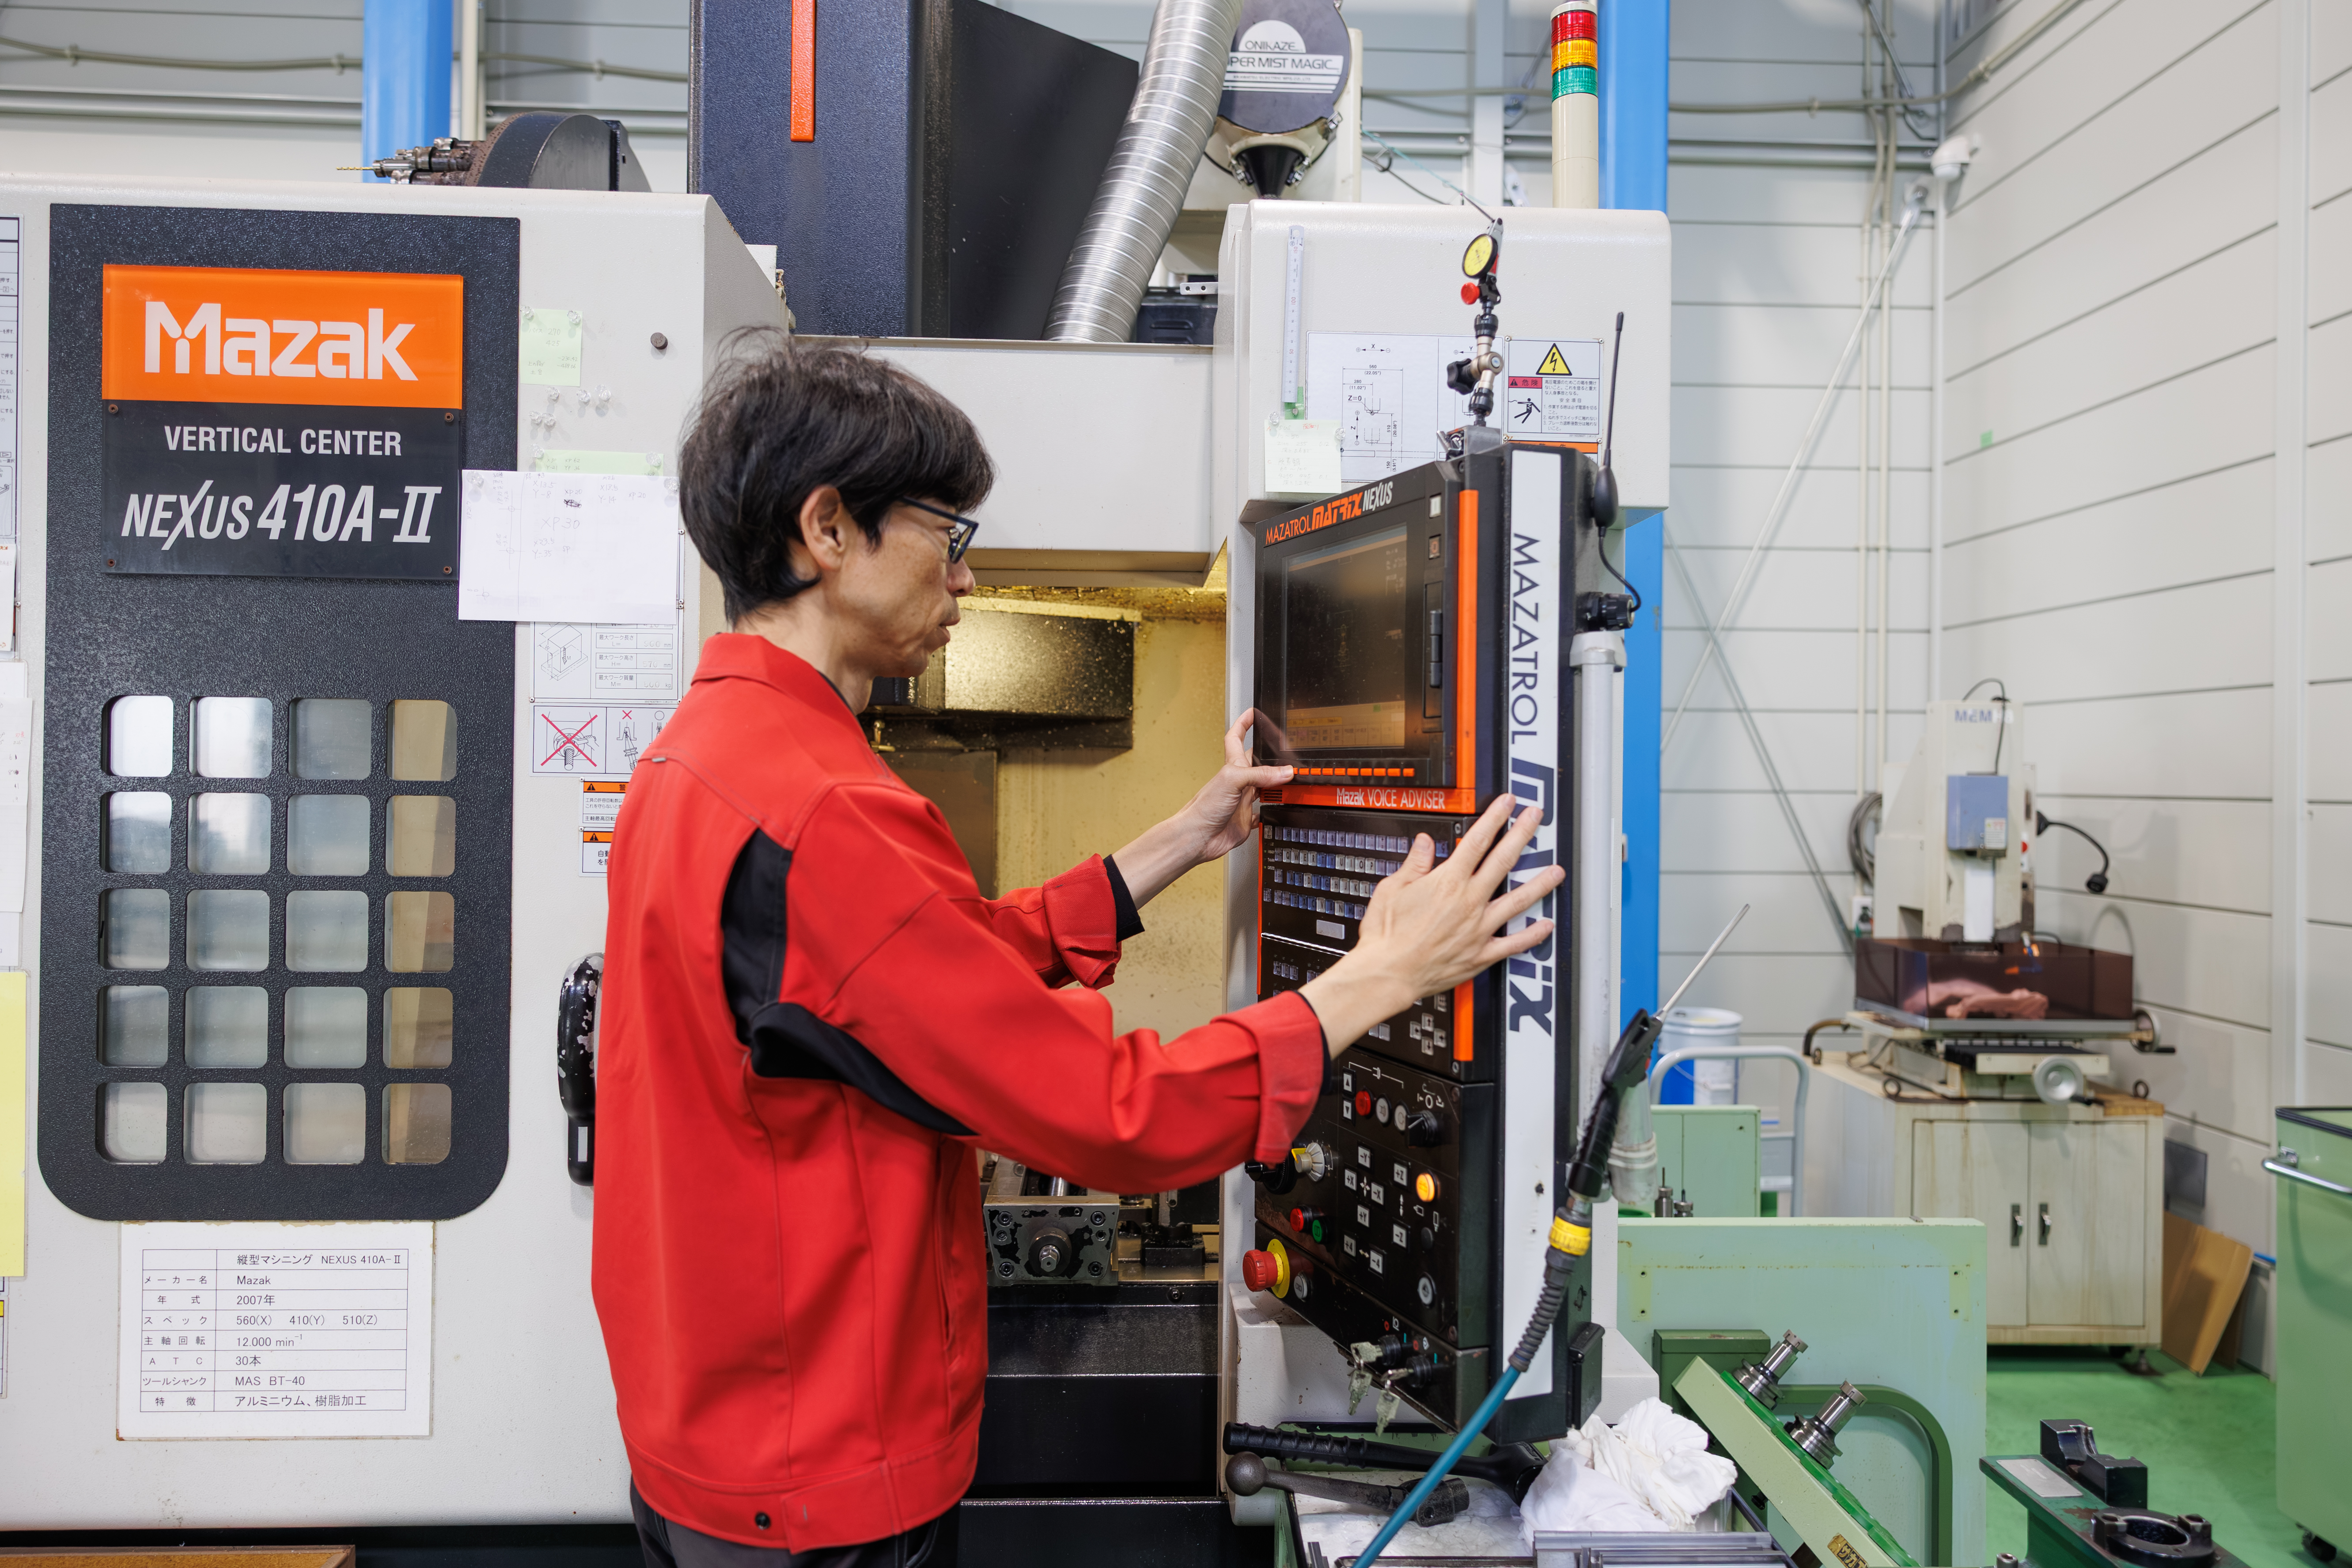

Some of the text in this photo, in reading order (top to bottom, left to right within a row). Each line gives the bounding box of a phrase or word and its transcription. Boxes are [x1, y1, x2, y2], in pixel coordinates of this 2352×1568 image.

[1258, 57, 1288, 68] MIST
[1292, 59, 1339, 70] MAGIC
[145, 302, 418, 380] Mazak
[165, 425, 401, 456] VERTICAL CENTER
[122, 480, 252, 550] NEXUS
[1265, 515, 1311, 545] MAZATROL
[1362, 481, 1393, 511] NEXUS
[1511, 534, 1540, 745] MAZATROL
[1337, 788, 1446, 810] Mazak VOICE ADVISER
[1346, 1175, 1354, 1186] +X
[1395, 1168, 1404, 1181] +Z
[1359, 1212, 1367, 1222] +Y
[237, 1254, 312, 1265] 縦型マシニング
[321, 1255, 356, 1265] NEXUS
[144, 1276, 271, 1285] メーカー名 Mazak
[236, 1295, 276, 1306] 2007年
[236, 1315, 272, 1326] 560(X)
[289, 1315, 325, 1326] 410(Y)
[343, 1314, 378, 1326] 510(Z)
[236, 1337, 272, 1347] 12.000
[235, 1356, 261, 1367] 30本
[143, 1376, 305, 1386] ツールシャンク MAS BT-40
[235, 1395, 367, 1407] アルミニウム、樹脂加工
